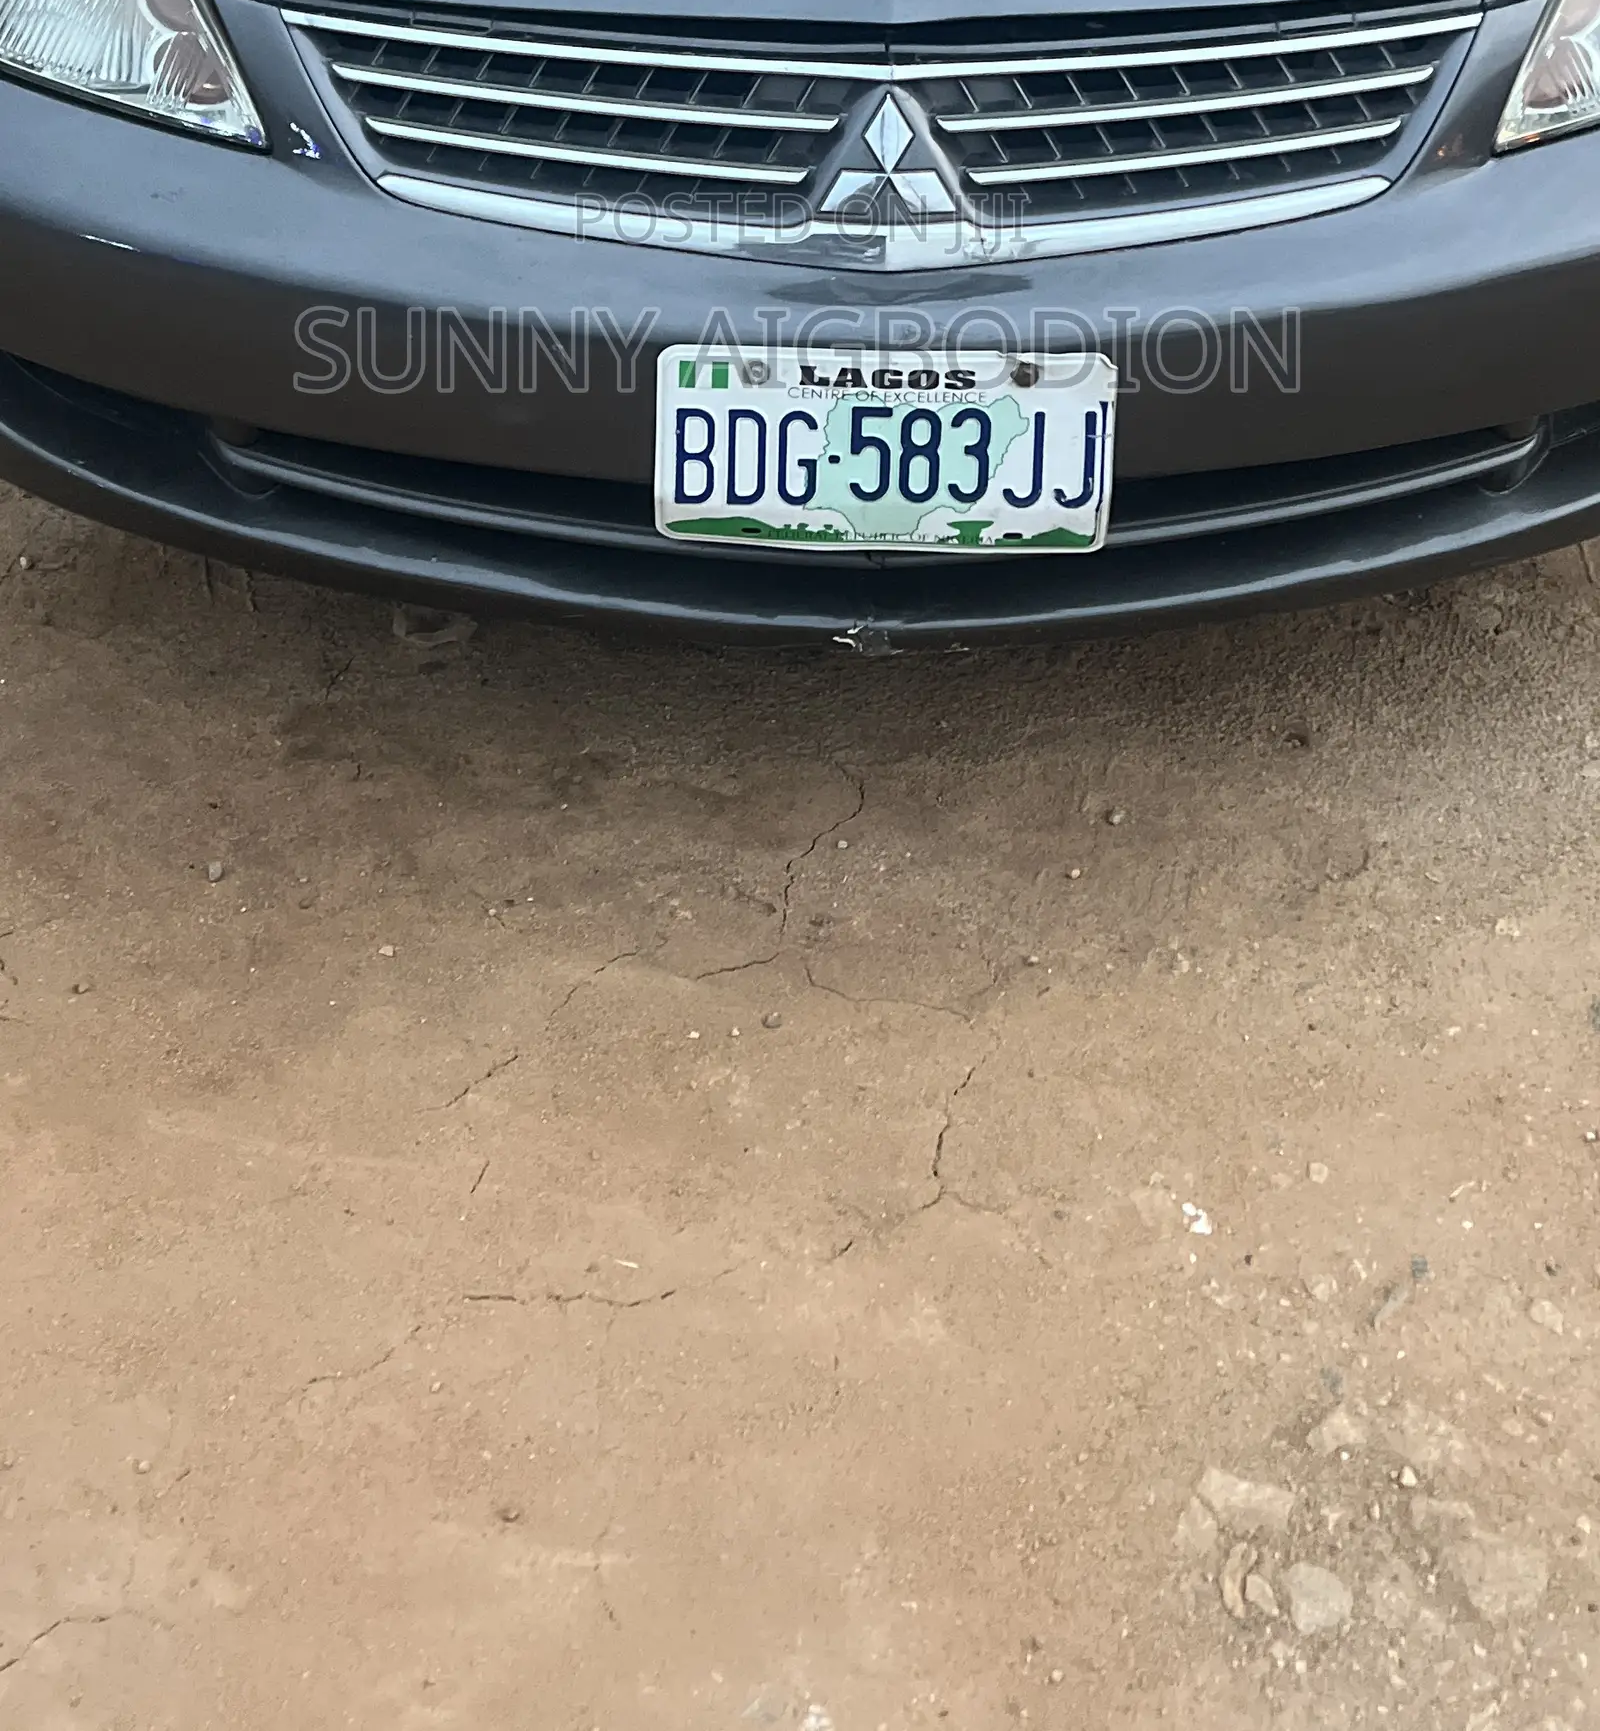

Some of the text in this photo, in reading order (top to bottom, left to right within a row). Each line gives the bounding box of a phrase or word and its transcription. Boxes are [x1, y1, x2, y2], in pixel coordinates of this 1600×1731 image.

[799, 365, 976, 390] LAGOS
[787, 386, 987, 404] CENTRE OF EXCELLENCE
